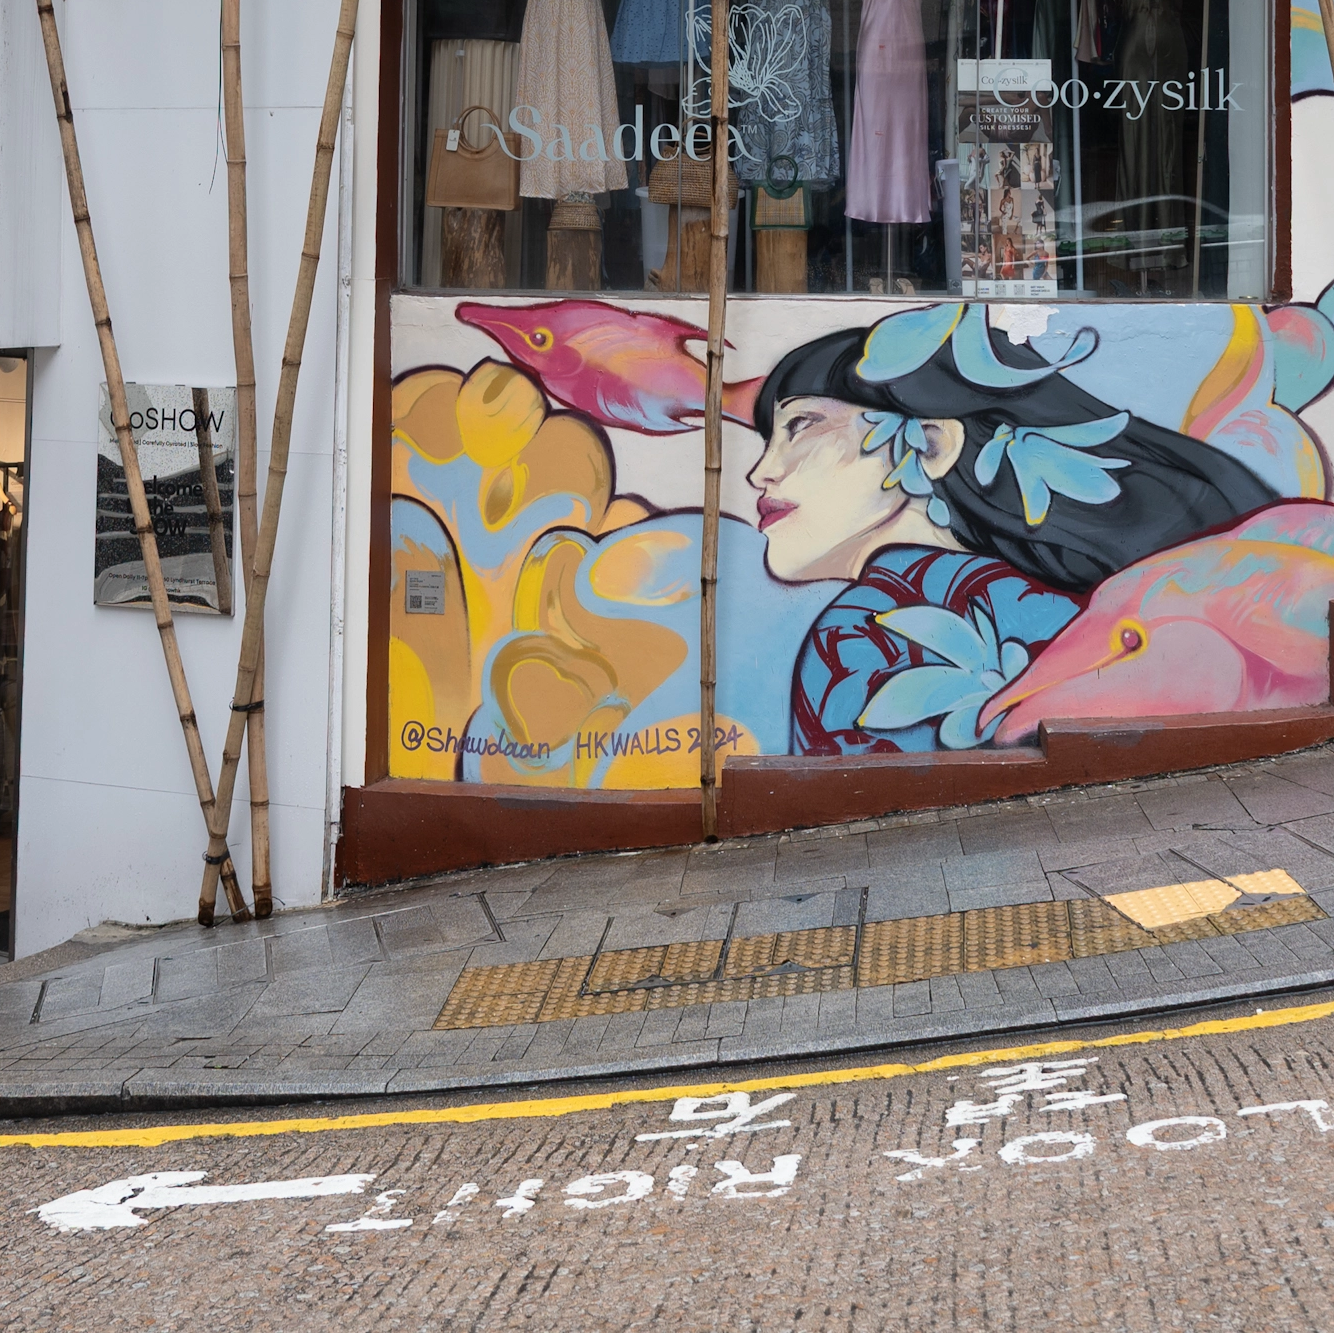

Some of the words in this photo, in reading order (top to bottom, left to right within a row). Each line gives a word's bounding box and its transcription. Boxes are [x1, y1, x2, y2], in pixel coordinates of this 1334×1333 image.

[969, 114, 1041, 123] CUSTOMISED
[144, 475, 203, 496] elcome
[576, 730, 682, 759] HKWALLS
[687, 725, 743, 754] 224
